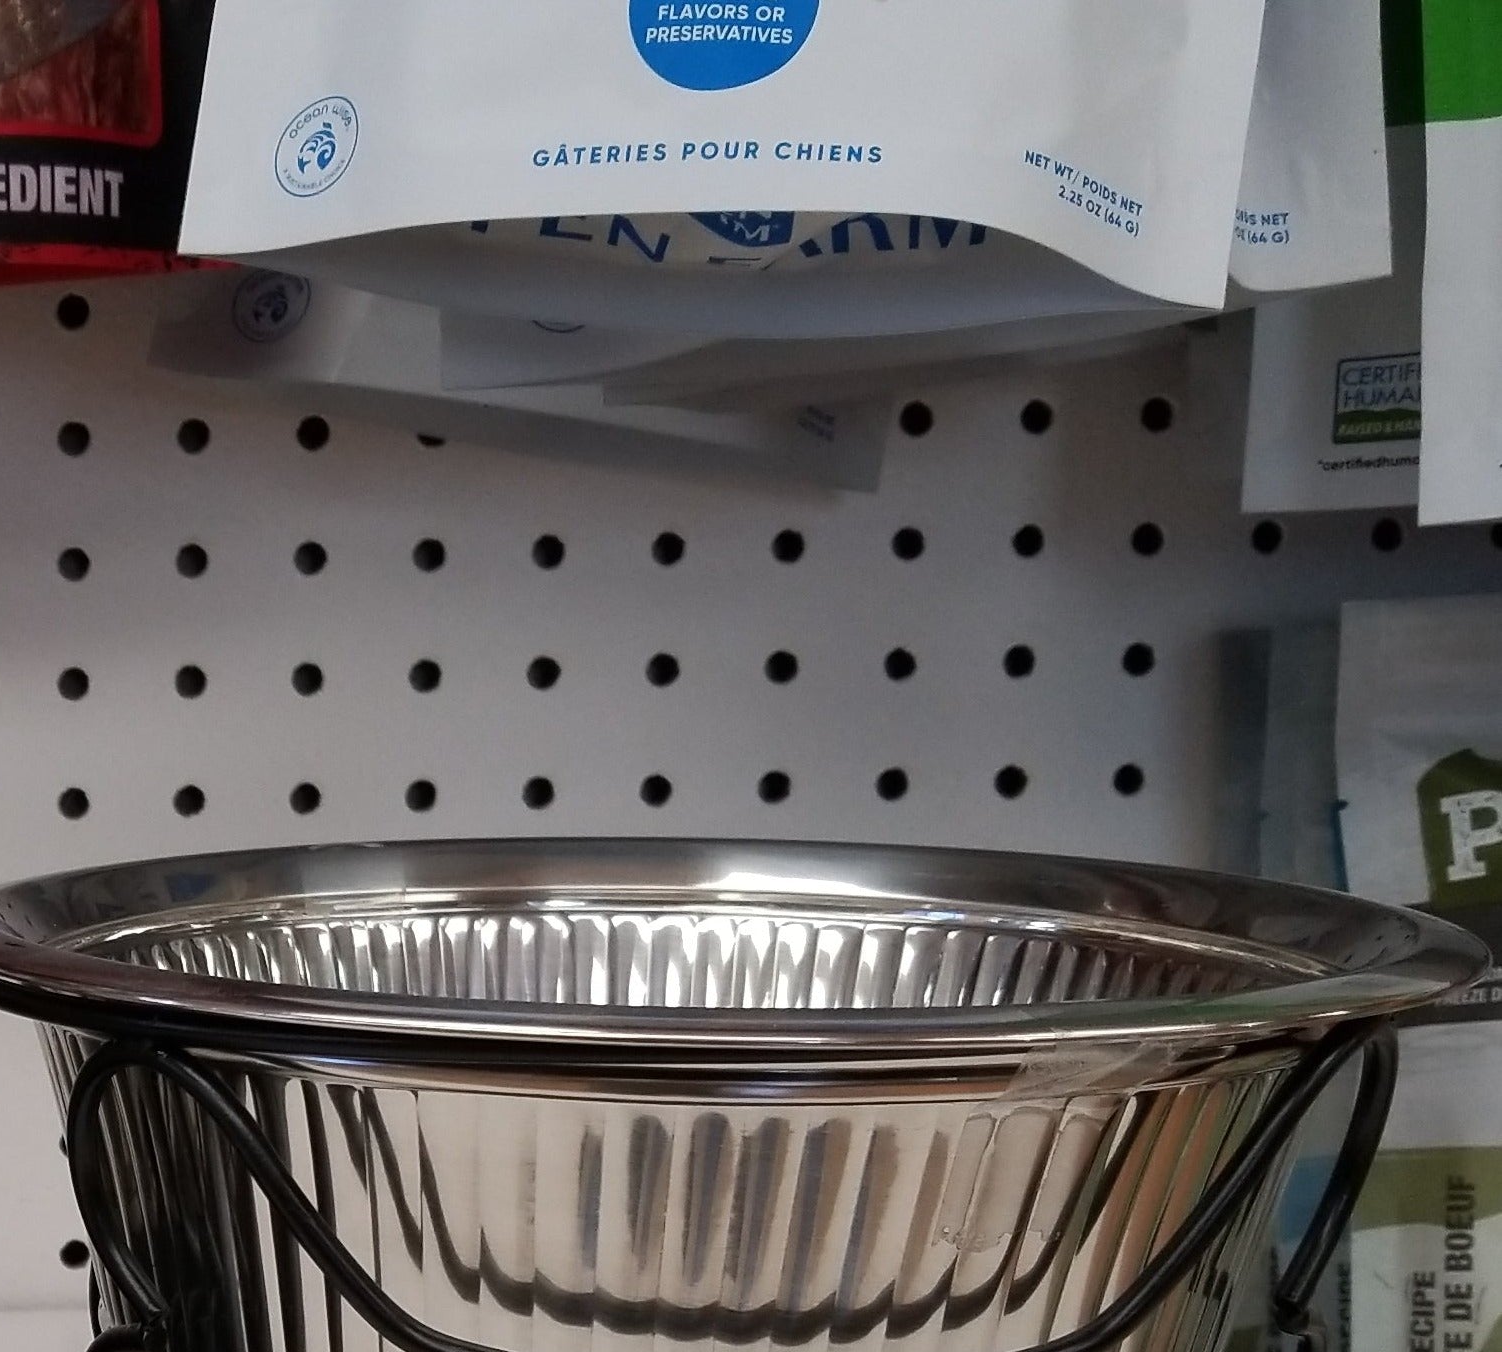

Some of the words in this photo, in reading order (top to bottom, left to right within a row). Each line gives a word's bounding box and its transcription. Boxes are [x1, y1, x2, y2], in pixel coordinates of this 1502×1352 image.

[658, 4, 749, 21] FLAVORS
[755, 6, 786, 22] OR
[646, 25, 794, 44] PRESERVATIVES
[289, 104, 329, 139] ocean
[532, 143, 668, 167] GÂTERIES
[681, 141, 760, 161] POUR
[774, 141, 883, 163] CHIENS
[1024, 150, 1051, 170] NET
[1082, 175, 1117, 204] POIDS
[1119, 195, 1143, 216] NET
[1058, 185, 1083, 207] 2.25
[1086, 199, 1102, 217] OZ
[1261, 212, 1290, 226] NET
[1343, 386, 1421, 407] HUMA
[1444, 1174, 1475, 1272] BOEUF
[1444, 1282, 1474, 1322] DE
